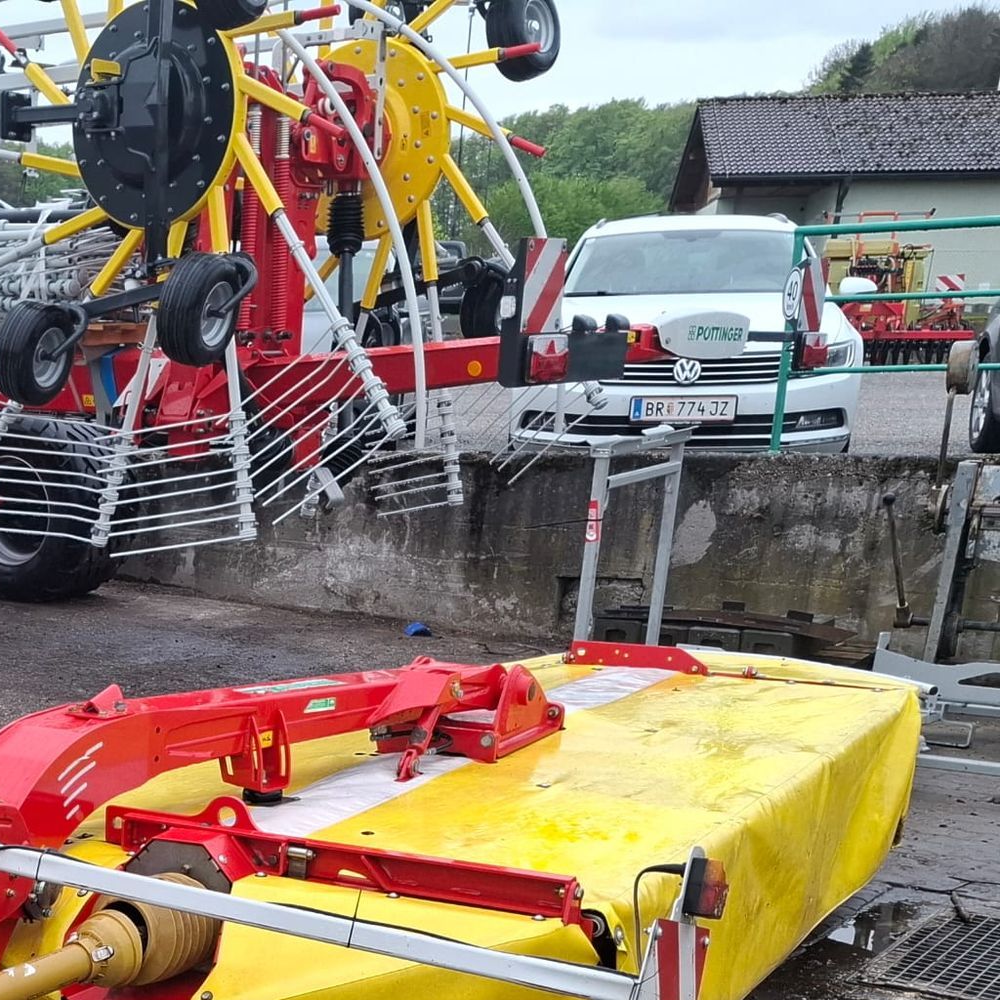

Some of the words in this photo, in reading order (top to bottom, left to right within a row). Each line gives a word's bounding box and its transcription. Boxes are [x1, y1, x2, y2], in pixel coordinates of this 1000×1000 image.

[787, 281, 799, 300] 40
[645, 401, 665, 416] BR
[677, 401, 705, 416] 774
[709, 401, 729, 416] JZ
